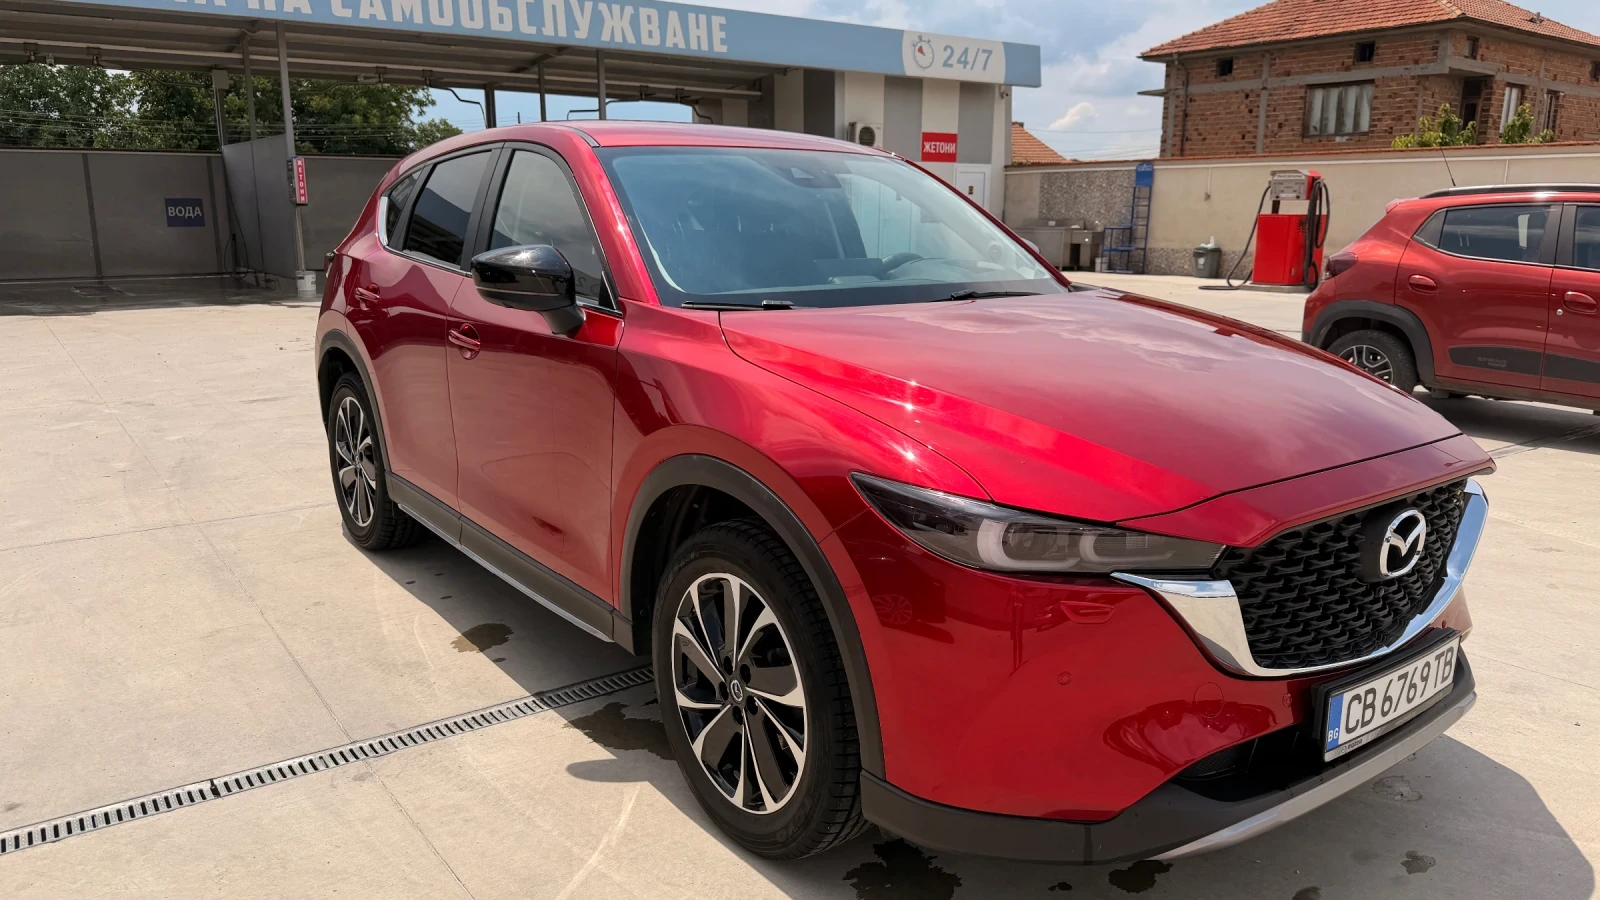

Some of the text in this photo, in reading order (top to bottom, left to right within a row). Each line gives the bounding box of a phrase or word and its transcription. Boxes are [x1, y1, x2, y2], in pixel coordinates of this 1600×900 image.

[941, 45, 993, 72] 24/7
[923, 141, 956, 154] ЖЕТОНИ
[297, 160, 306, 202] ЖЕТОНИ
[167, 206, 203, 219] ВОДА
[1345, 687, 1377, 735] CB
[1380, 660, 1431, 718] 6769
[1328, 728, 1339, 742] BG
